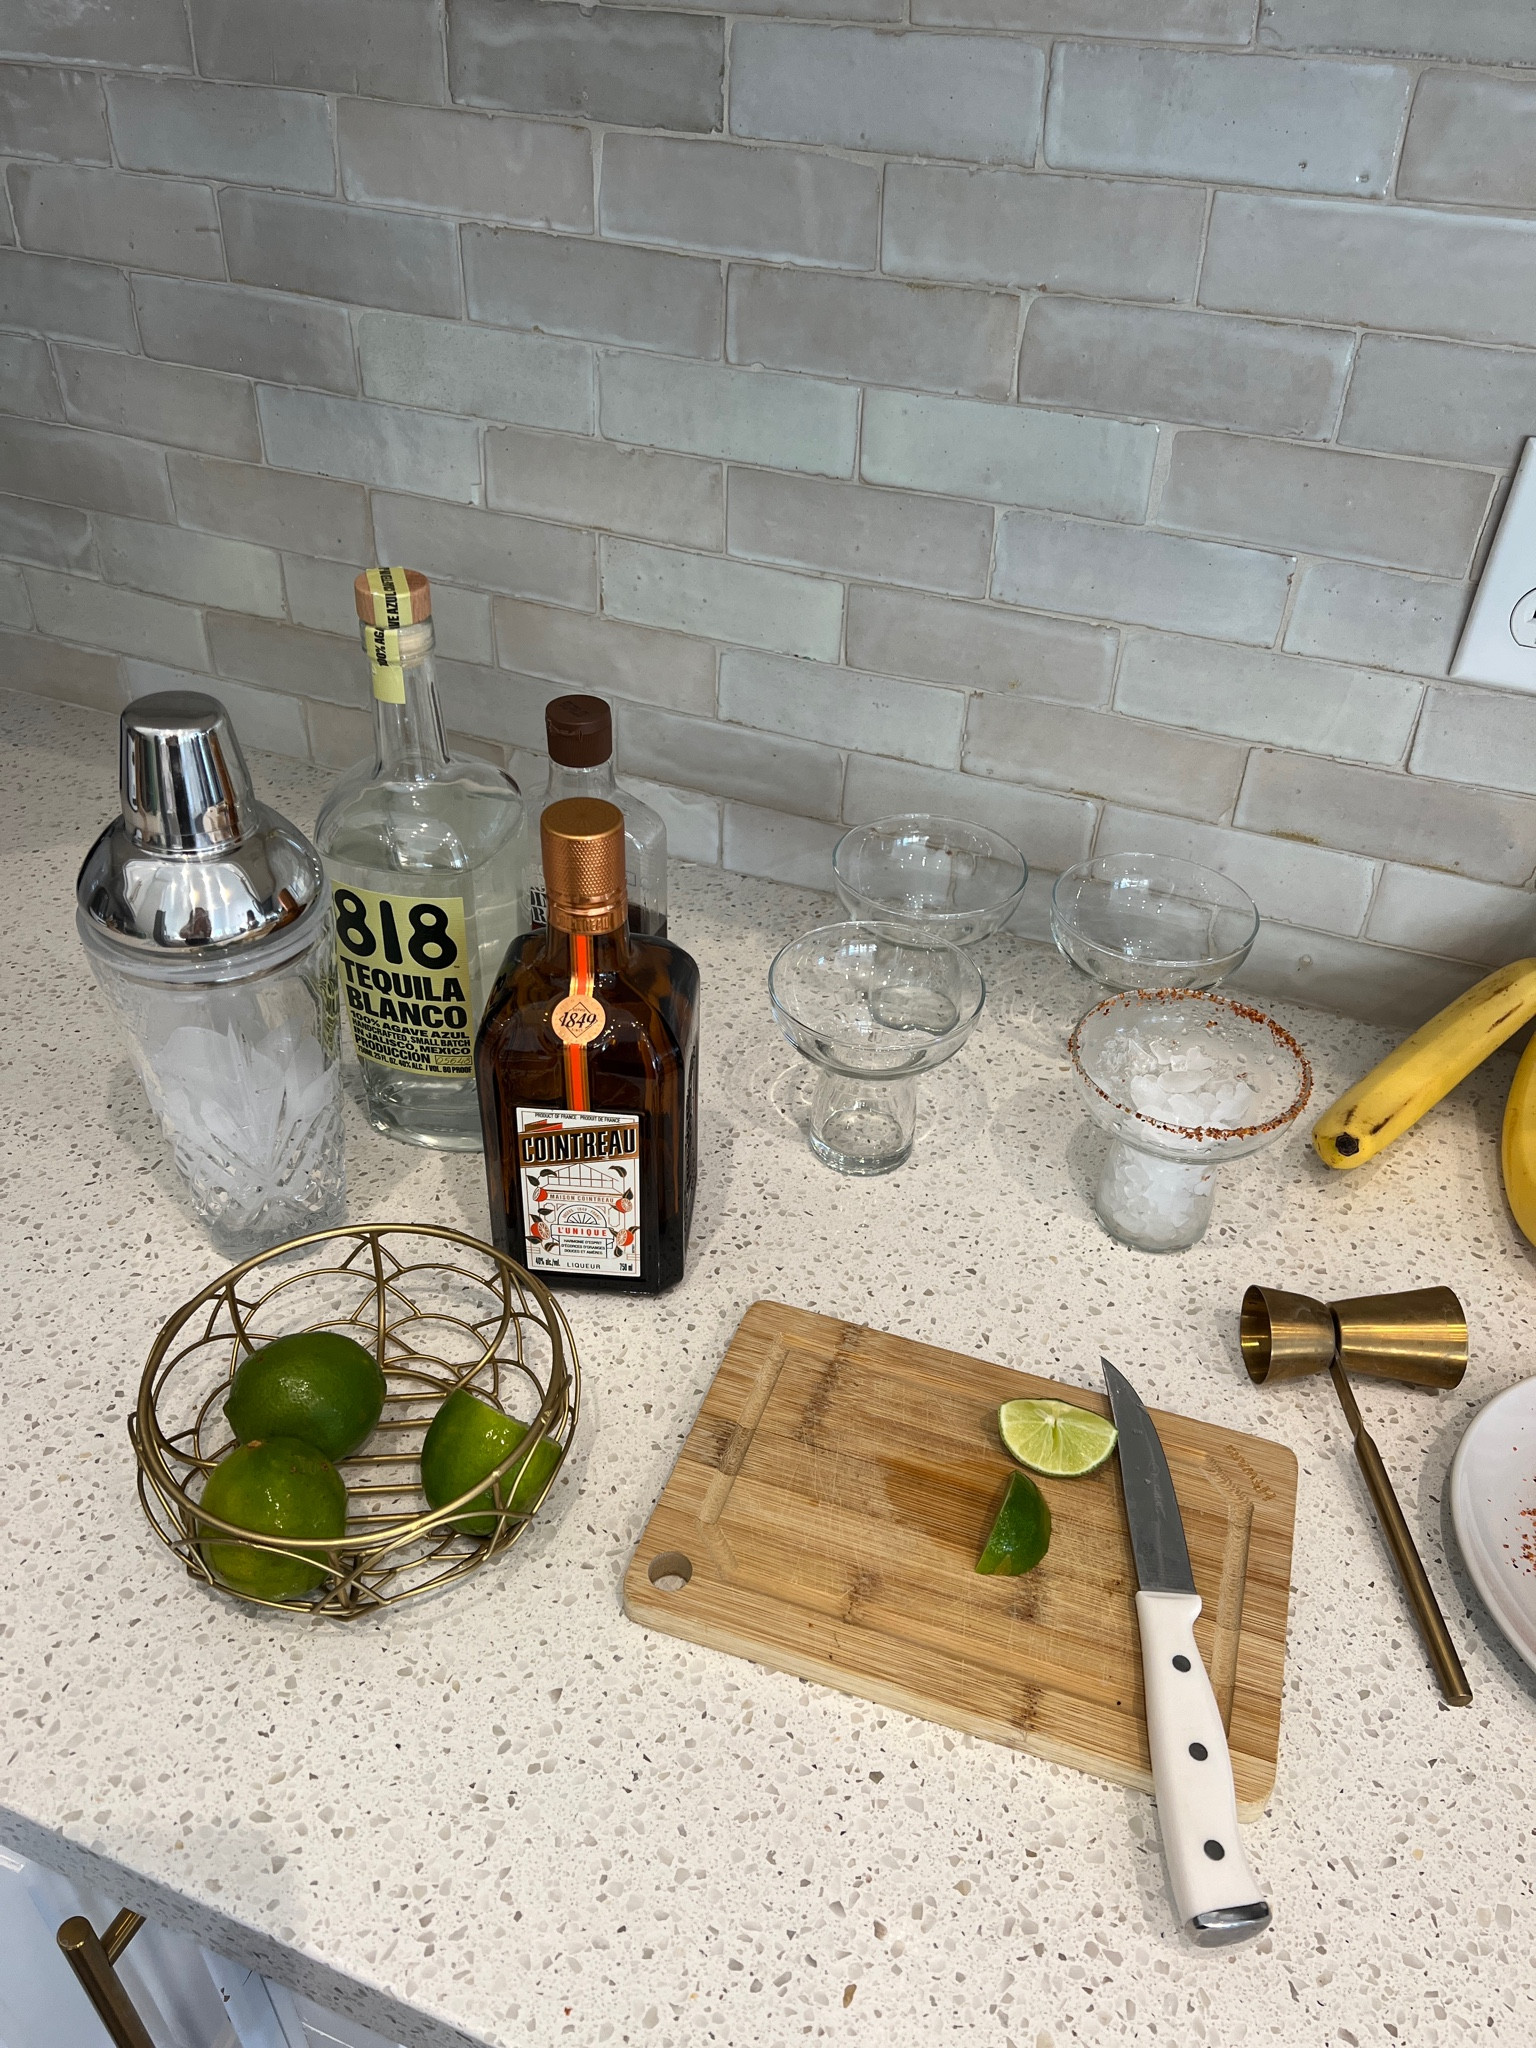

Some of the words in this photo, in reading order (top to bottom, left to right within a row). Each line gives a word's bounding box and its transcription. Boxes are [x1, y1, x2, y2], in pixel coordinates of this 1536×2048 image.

[385, 592, 399, 615] AZUL
[334, 888, 458, 970] 818
[339, 955, 466, 1002] TEQUILA
[345, 984, 468, 1029] BLANCO
[351, 1010, 381, 1028] 100%
[382, 1022, 428, 1038] AGAVE
[431, 1031, 470, 1039] AZUL
[560, 1011, 597, 1029] 1849
[353, 1025, 364, 1036] IN
[419, 1045, 471, 1055] MEXICO
[355, 1033, 431, 1064] PRODUCCIÓN
[410, 1035, 440, 1046] SMALL
[440, 1039, 471, 1047] BATCH
[452, 1066, 473, 1074] PROOF
[521, 1128, 637, 1163] COINTREAU
[577, 1195, 614, 1203] COINTREAU
[557, 1226, 608, 1237] L'UNIQUE
[566, 1261, 601, 1270] LIQUEUR
